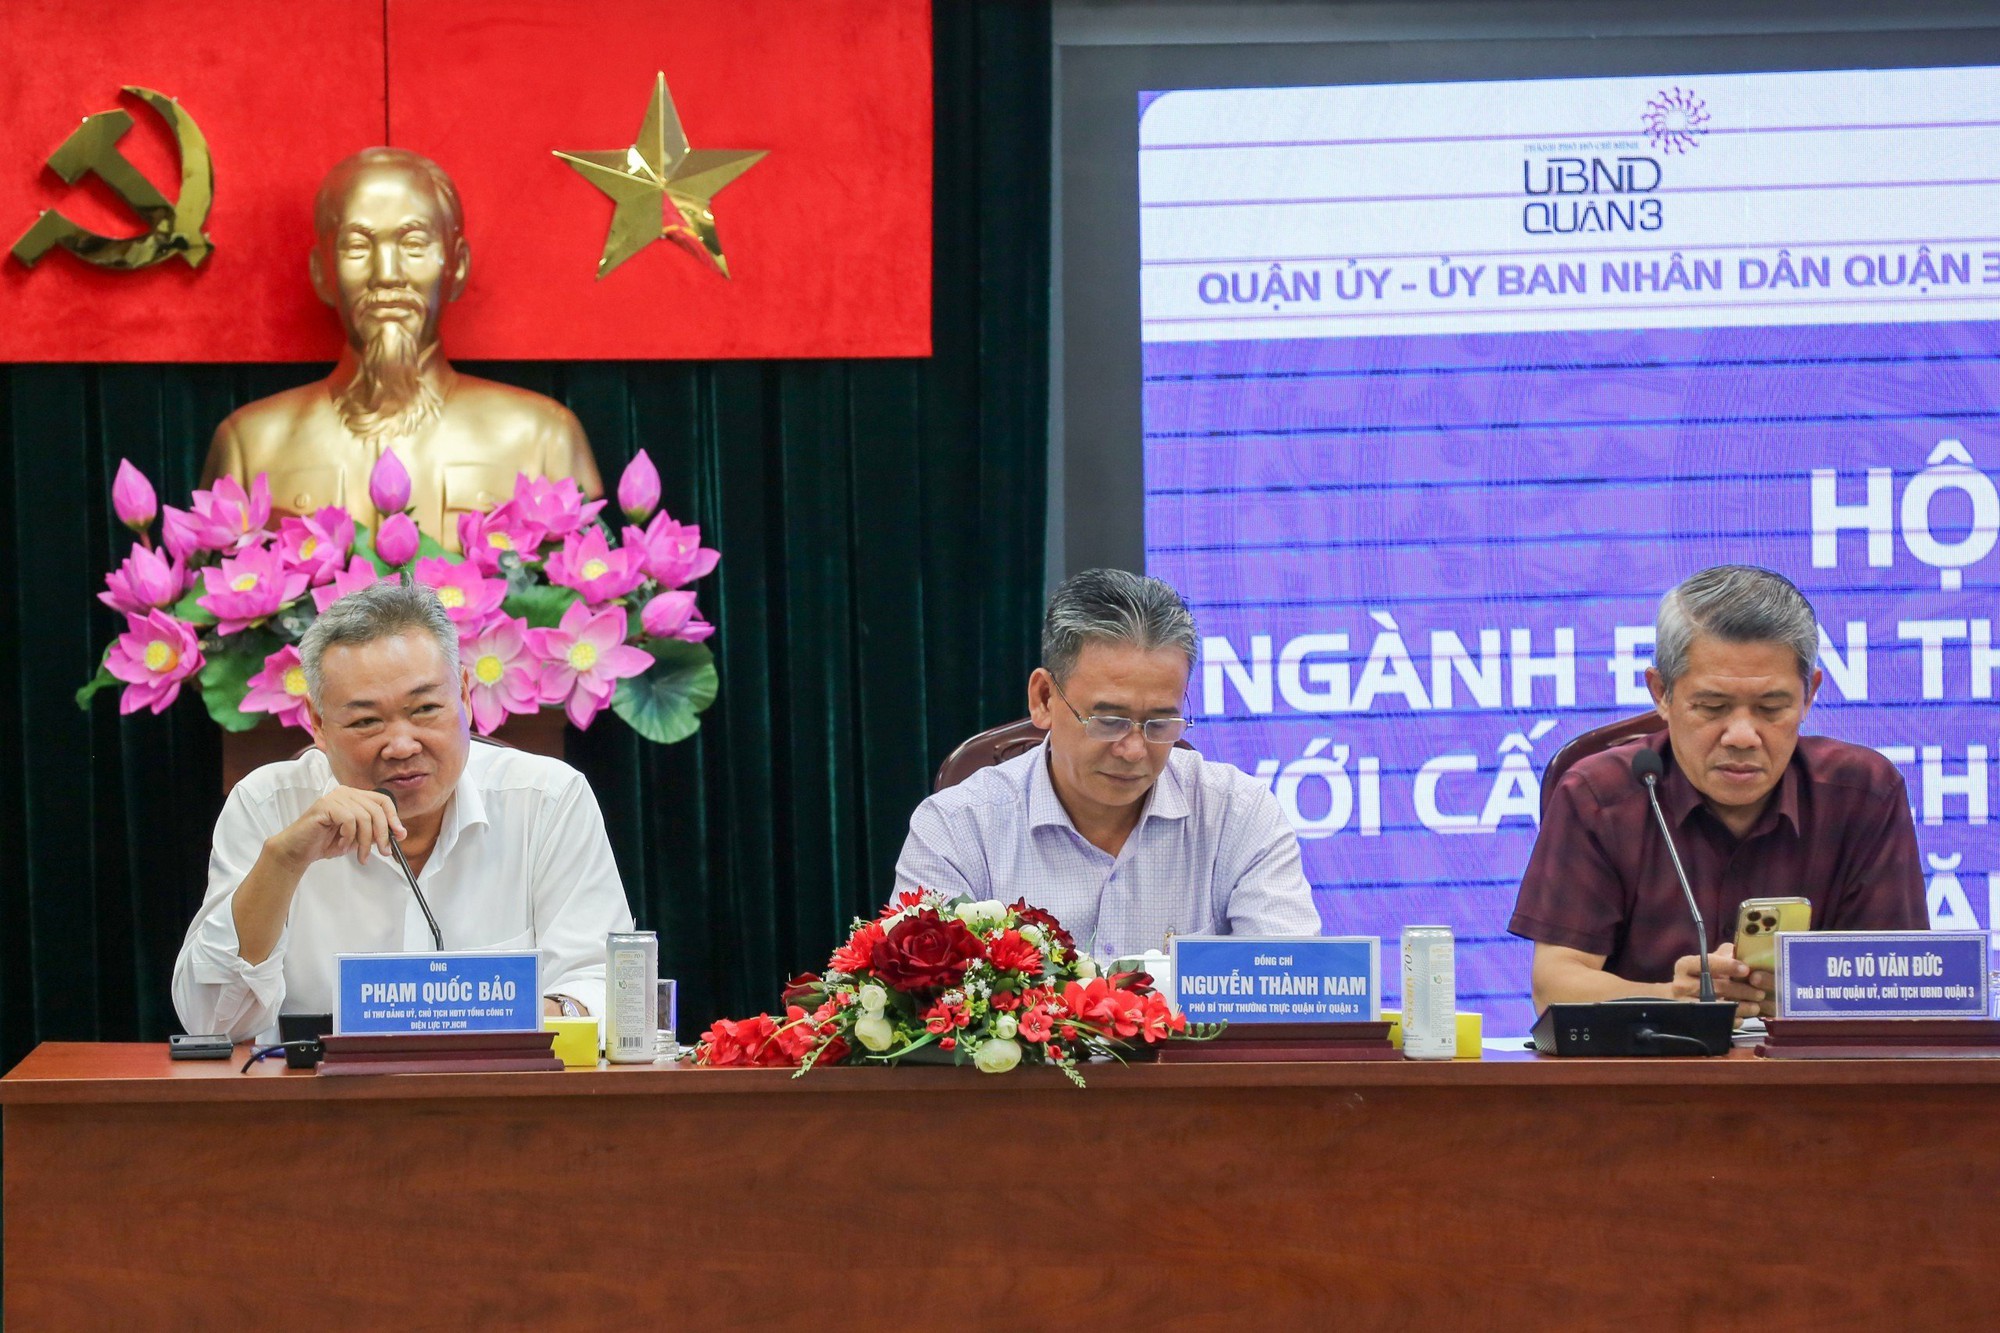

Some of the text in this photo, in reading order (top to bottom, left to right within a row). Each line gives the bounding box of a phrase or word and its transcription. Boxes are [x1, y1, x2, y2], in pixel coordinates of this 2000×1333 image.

[1524, 157, 1662, 195] UBND
[1197, 263, 1321, 312] QUẬN
[1336, 258, 1393, 300] ỦY
[1402, 283, 1417, 291] -
[1429, 255, 1486, 298] ỦY
[1497, 263, 1588, 296] BAN
[1602, 252, 1723, 293] NHÂN
[1739, 249, 1831, 290] DÂN
[1844, 245, 1971, 294] QUẬN
[1202, 610, 1576, 715] NGÀNH
[430, 961, 447, 972] ÔNG
[1279, 955, 1293, 966] CHÍ
[1827, 951, 1943, 977] Đ/c VÕ VĂN ĐỨC
[361, 974, 516, 1006] PHẠM QUỐC BẢO
[1181, 968, 1367, 996] NGUYỄN THÀNH NAM
[1797, 985, 1814, 999] PHÓ
[1815, 985, 1824, 999] BÍ
[1825, 985, 1842, 999] THƯ
[1843, 985, 1865, 1001] QUẬN
[1882, 983, 1899, 999] CHỦ
[1900, 986, 1918, 1001] TỊCH
[1920, 986, 1943, 998] UBND
[1944, 984, 1967, 1001] QUẬN
[1968, 986, 1975, 998] 3
[372, 1009, 385, 1018] THƯ
[433, 1009, 448, 1019] TỊCH
[505, 1008, 514, 1016] TY
[1189, 1001, 1359, 1015] PHÓ BÍ THƯ THƯỜNG TRỰC QUẬN ỦY QUẬN 3
[427, 1021, 441, 1030] LỰC
[442, 1020, 467, 1029] TP.HCM
